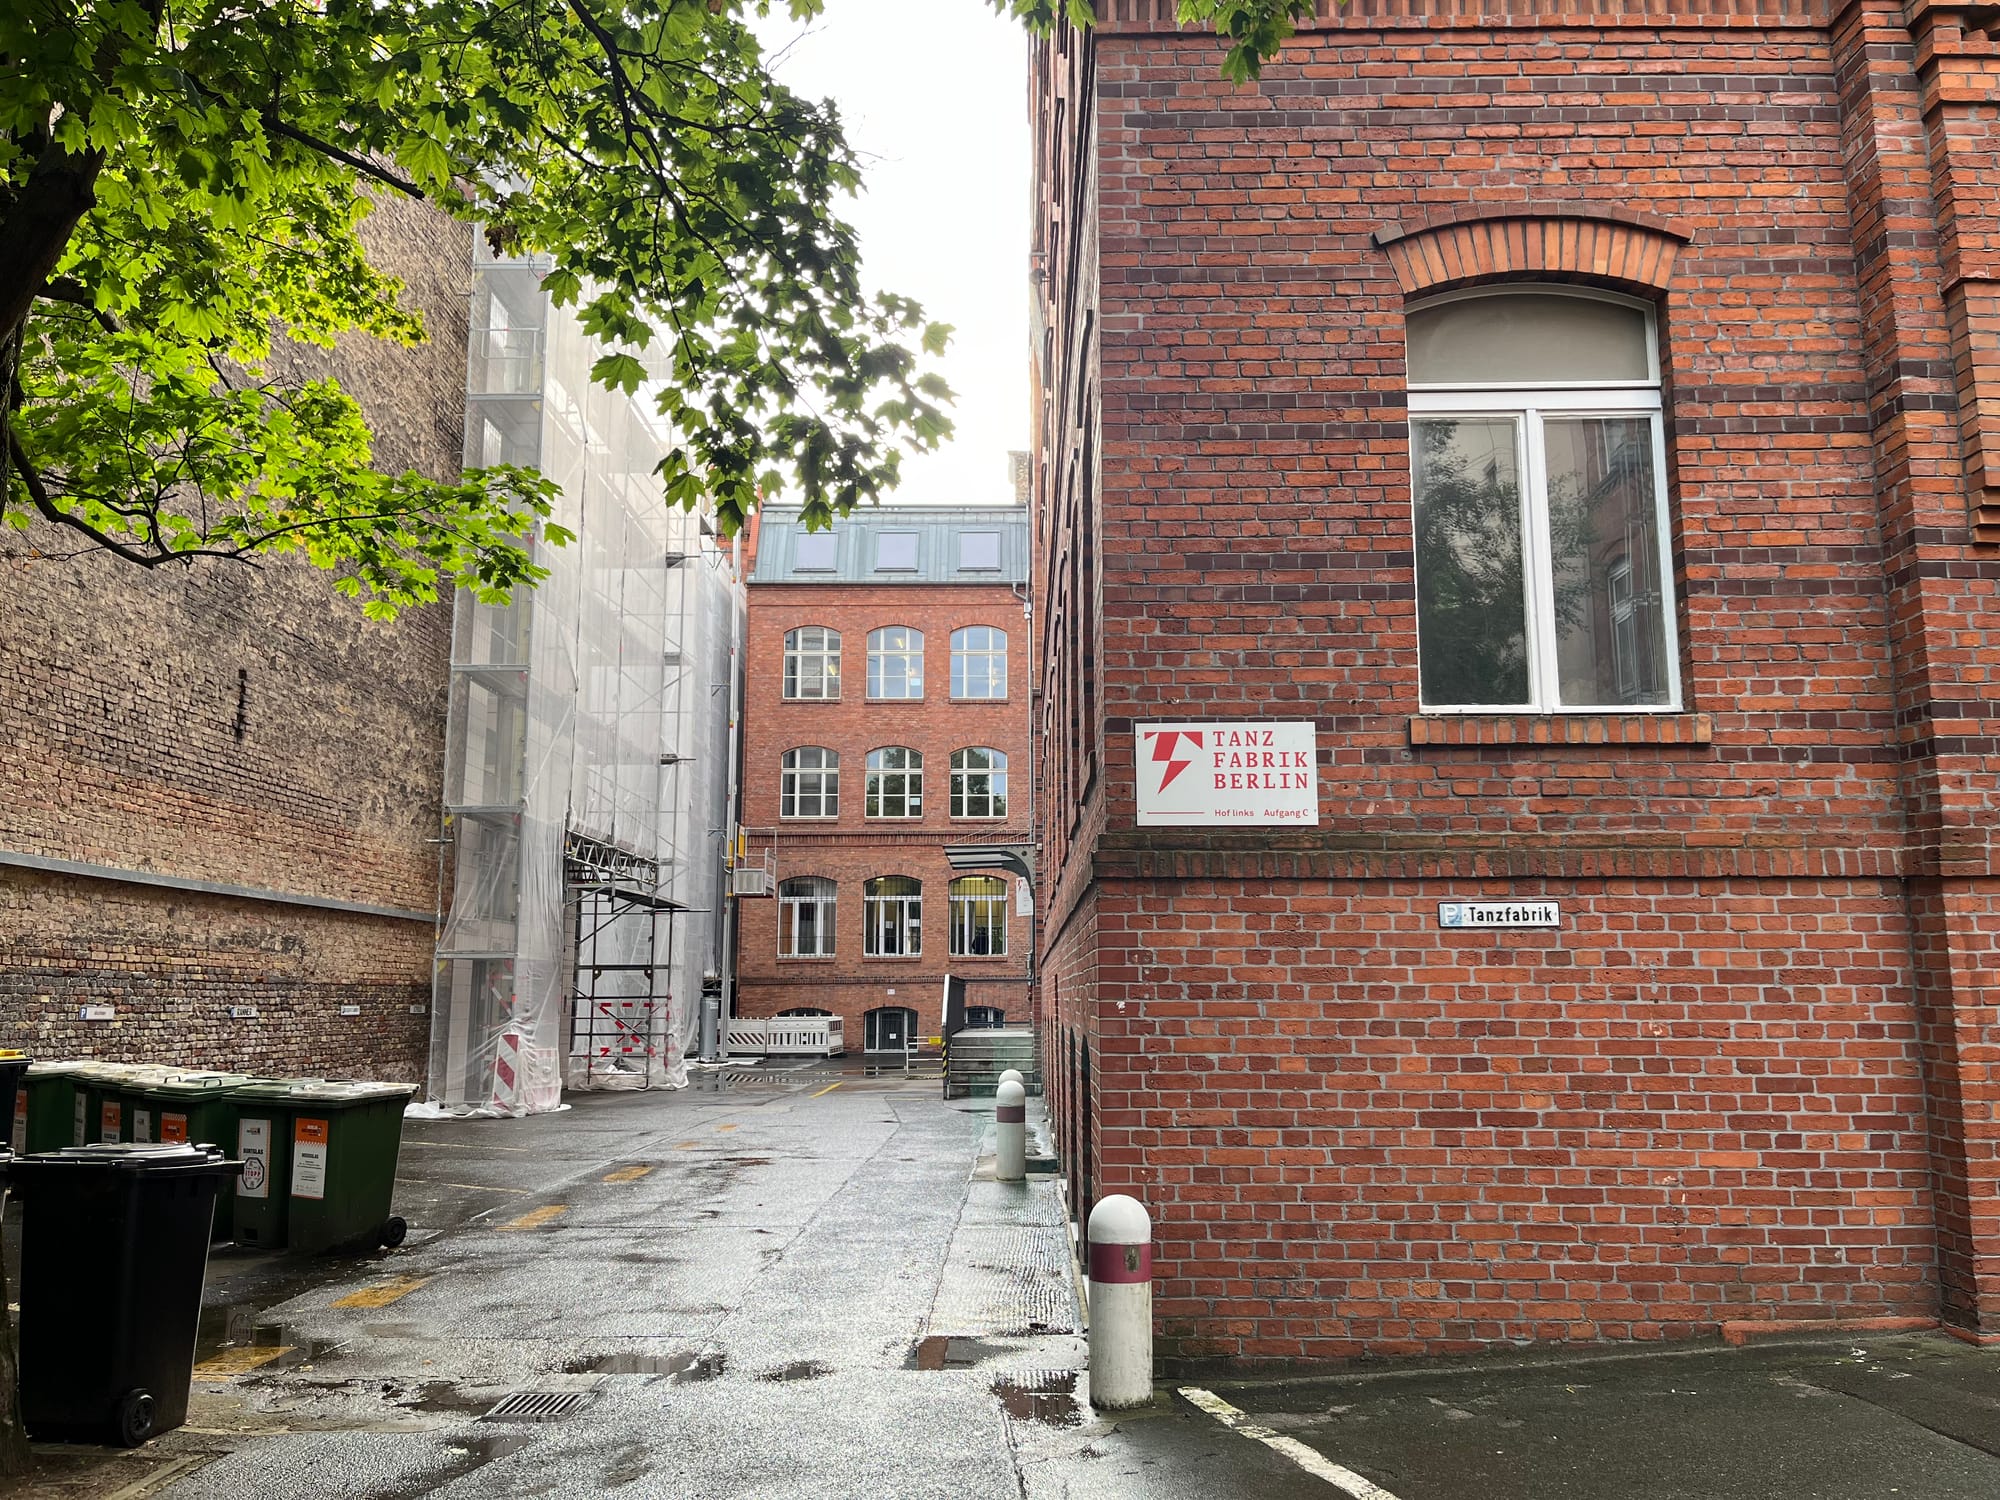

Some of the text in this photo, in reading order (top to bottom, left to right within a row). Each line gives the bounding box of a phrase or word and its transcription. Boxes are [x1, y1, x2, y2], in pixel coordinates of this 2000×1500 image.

[1213, 730, 1274, 747] TANZ
[1213, 751, 1308, 768] FABRIK
[1214, 772, 1308, 789] BERLIN
[1214, 809, 1309, 819] Hof links Aufgang C
[1469, 906, 1552, 922] Tanzfabrik
